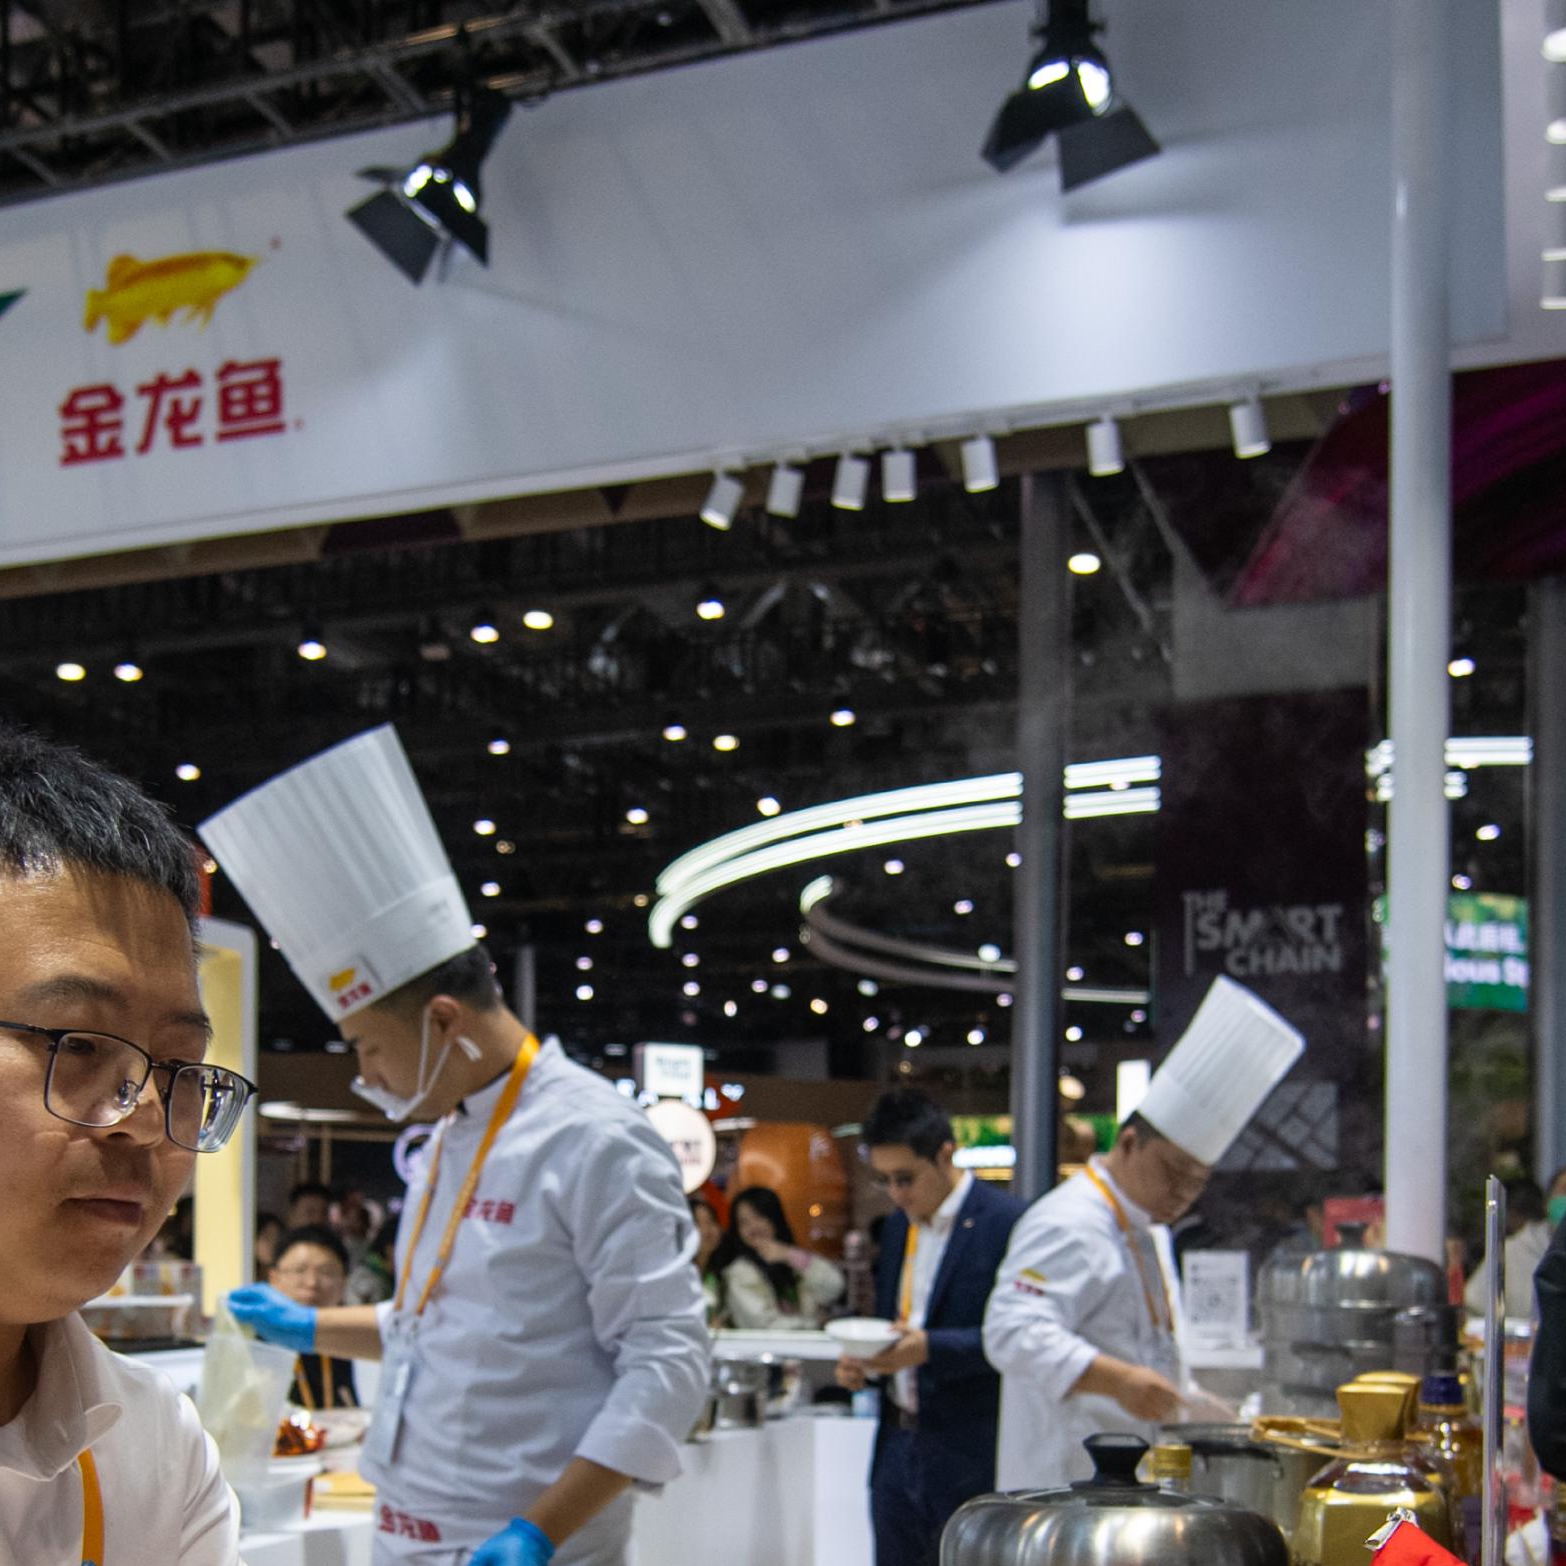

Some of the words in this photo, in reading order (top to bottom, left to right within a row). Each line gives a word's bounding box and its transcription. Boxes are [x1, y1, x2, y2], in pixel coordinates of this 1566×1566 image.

[60, 357, 288, 468] 金龙鱼
[1224, 943, 1342, 976] CHAIN
